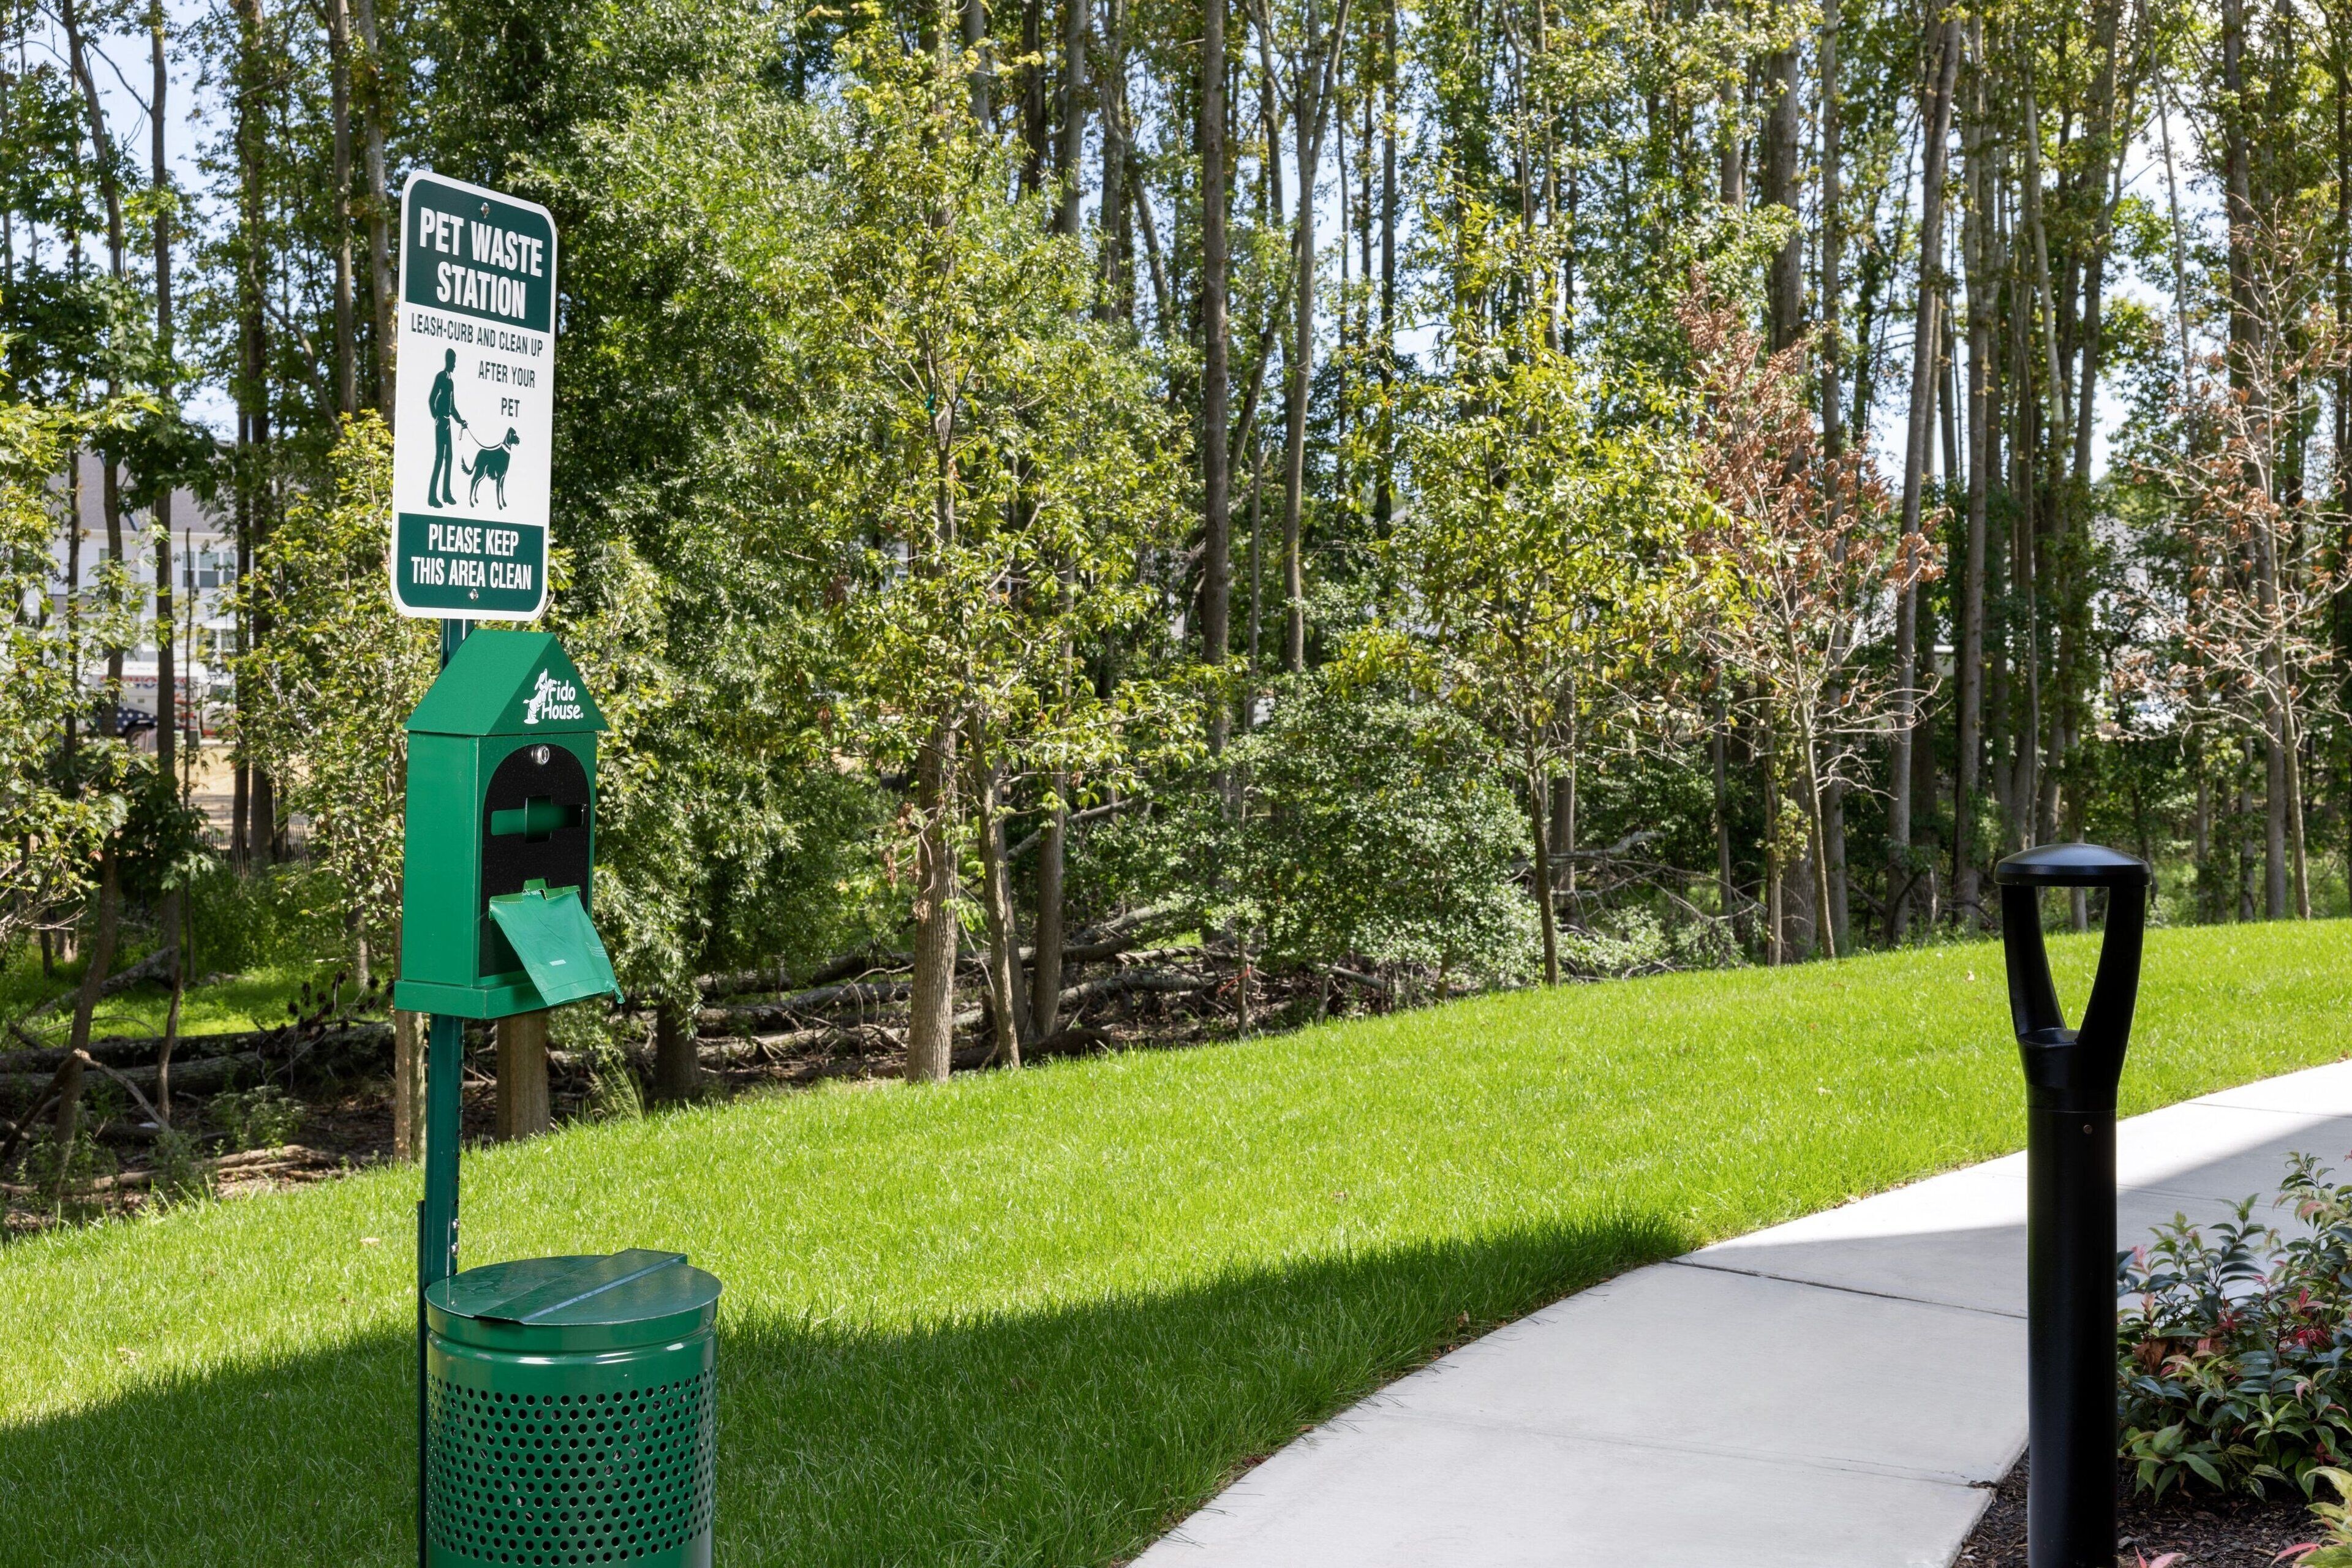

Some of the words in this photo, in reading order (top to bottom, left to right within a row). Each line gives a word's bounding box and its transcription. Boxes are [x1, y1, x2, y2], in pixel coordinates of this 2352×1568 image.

[420, 206, 464, 256] PET
[470, 221, 543, 277] WASTE
[436, 261, 526, 320] STATION
[412, 312, 473, 344] LEASH-CURB
[477, 326, 496, 348] AND
[499, 331, 528, 355] CLEAN
[531, 338, 543, 357] UP
[478, 360, 508, 383] AFTER
[511, 366, 535, 388] YOUR
[501, 397, 520, 418] PET
[428, 523, 482, 554] PLEASE
[485, 529, 519, 557] KEEP
[411, 556, 445, 586] THIS
[448, 559, 486, 587] AREA
[489, 561, 532, 590] CLEAN
[548, 678, 576, 701] Fido
